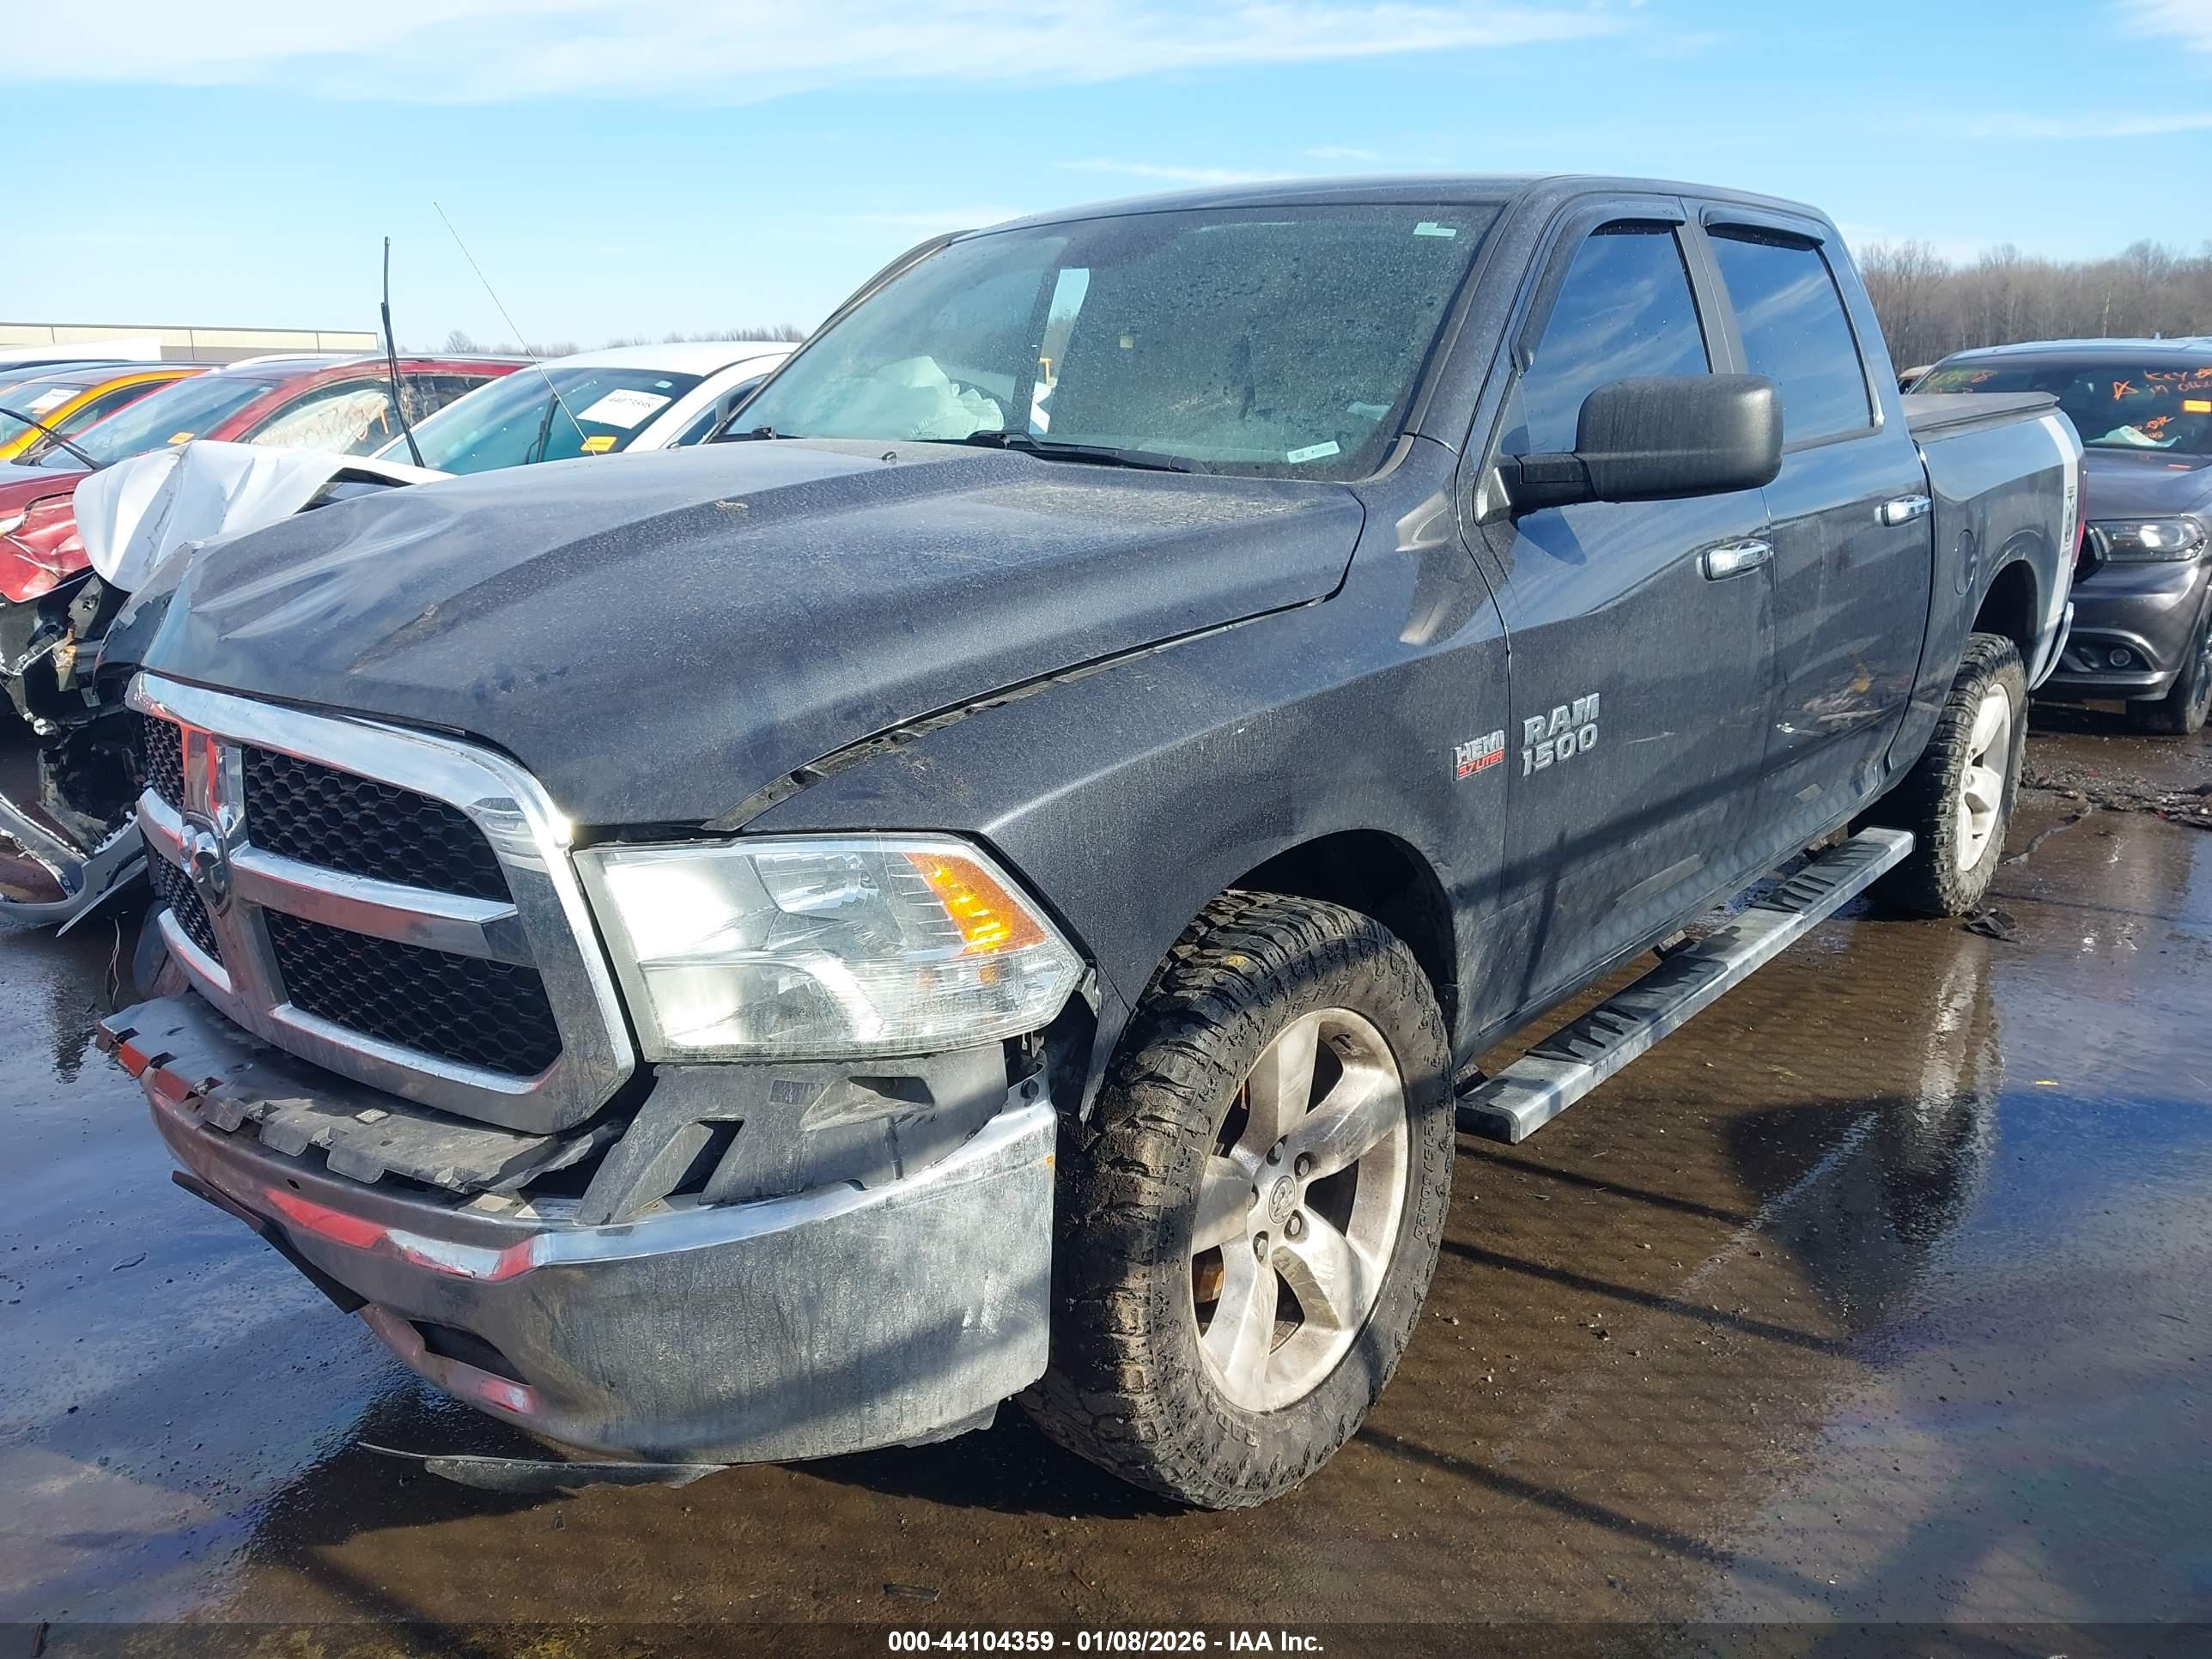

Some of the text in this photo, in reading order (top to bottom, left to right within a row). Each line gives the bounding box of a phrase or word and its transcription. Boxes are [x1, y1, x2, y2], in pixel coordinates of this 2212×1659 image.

[1522, 692, 1600, 746] RAM
[1455, 730, 1504, 764] HEMI
[1476, 750, 1504, 769] LITER
[1522, 723, 1598, 777] 1500
